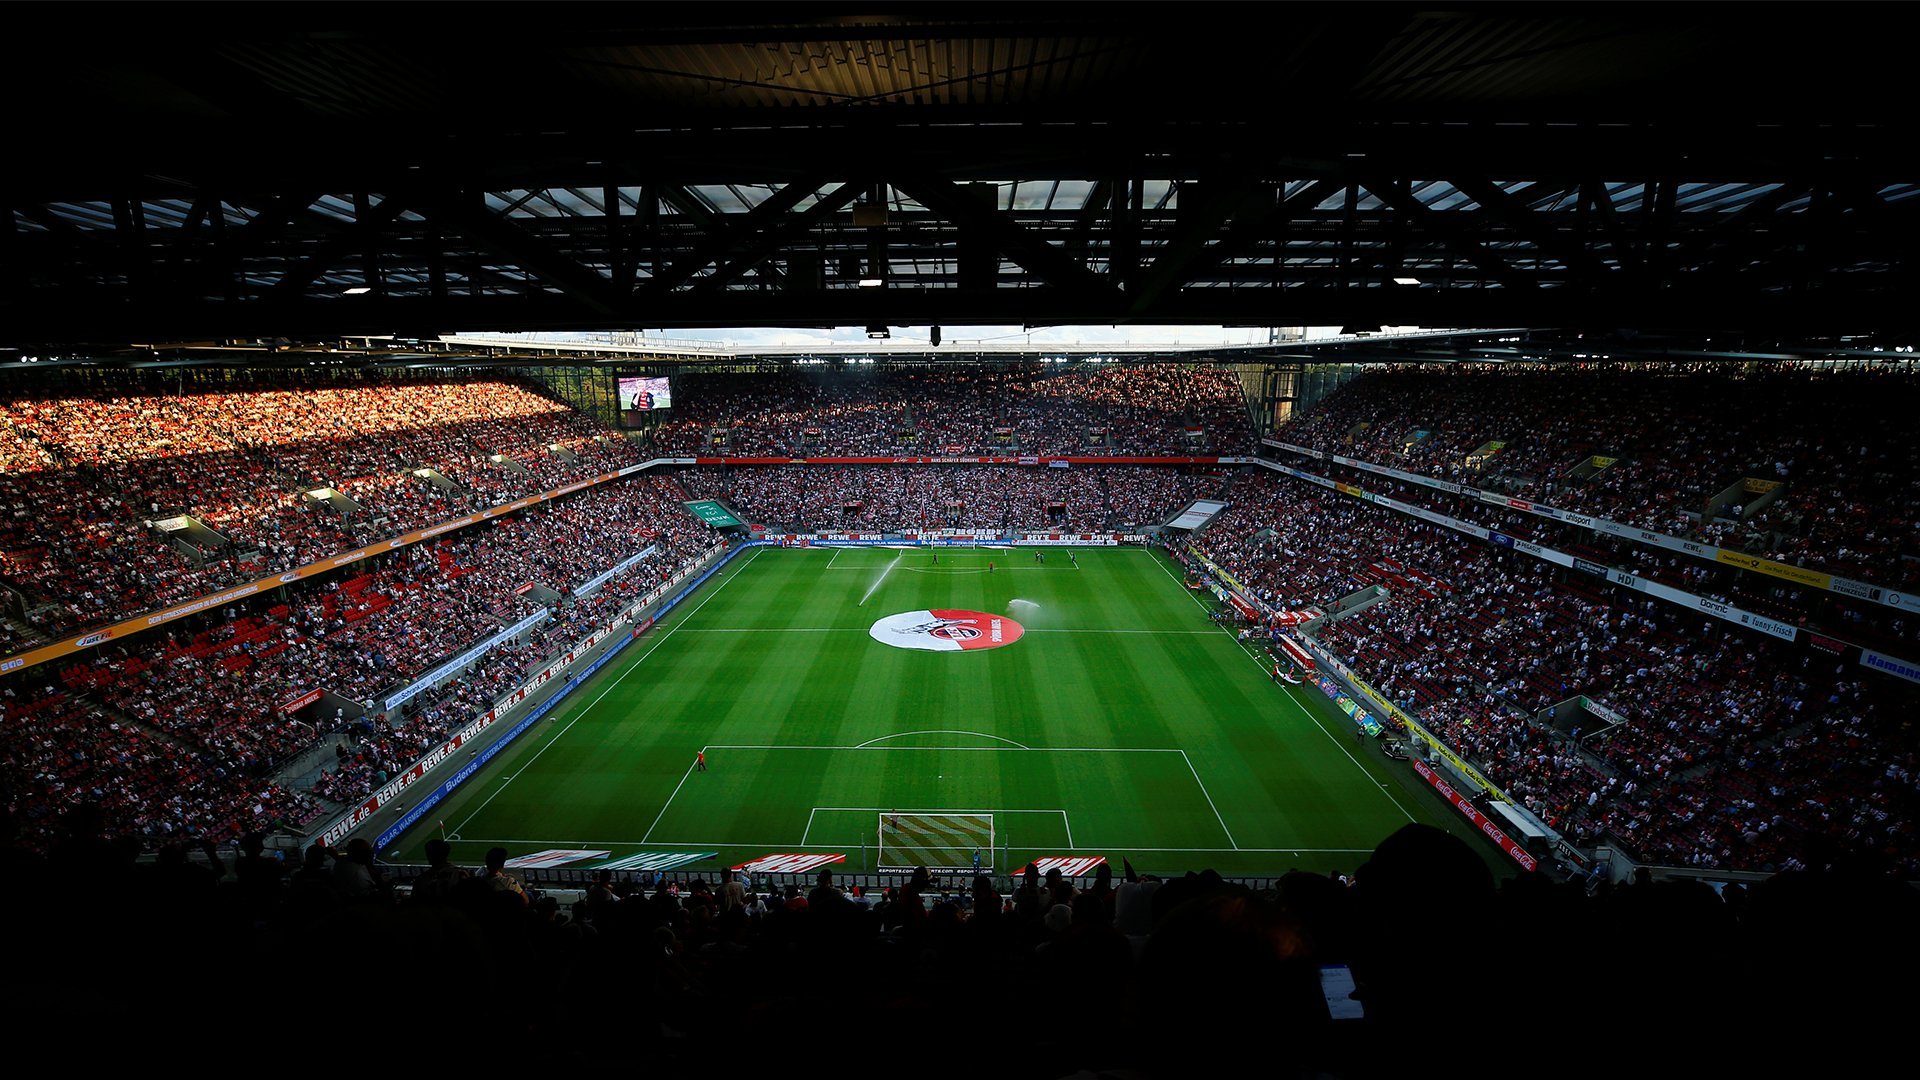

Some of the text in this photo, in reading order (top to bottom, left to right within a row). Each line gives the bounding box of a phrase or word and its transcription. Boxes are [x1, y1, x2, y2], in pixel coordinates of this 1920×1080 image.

[1565, 513, 1590, 526] uhlsport
[1617, 572, 1634, 587] HDI
[1834, 579, 1868, 592] DEUTSCHE
[1700, 597, 1727, 614] Dorint
[1752, 617, 1792, 637] funny-frisch
[549, 653, 569, 678] REWE.de
[523, 671, 546, 697] REWE.de
[494, 690, 520, 719] REWE.de
[460, 712, 490, 745] REWE.de
[421, 738, 455, 775] REWE.de
[445, 759, 477, 793] Buderus
[1415, 761, 1431, 780] Coca-Cola
[376, 767, 415, 808] REWE.de
[1436, 780, 1452, 799] Coca-Cola
[377, 791, 439, 850] SOLAR, WÄRMEPUMPEN
[1458, 800, 1476, 820] Coca-Cola
[323, 805, 370, 849] REWE.de
[1483, 822, 1502, 844] Coca-Cola
[1511, 846, 1534, 871] Coca-Cola
